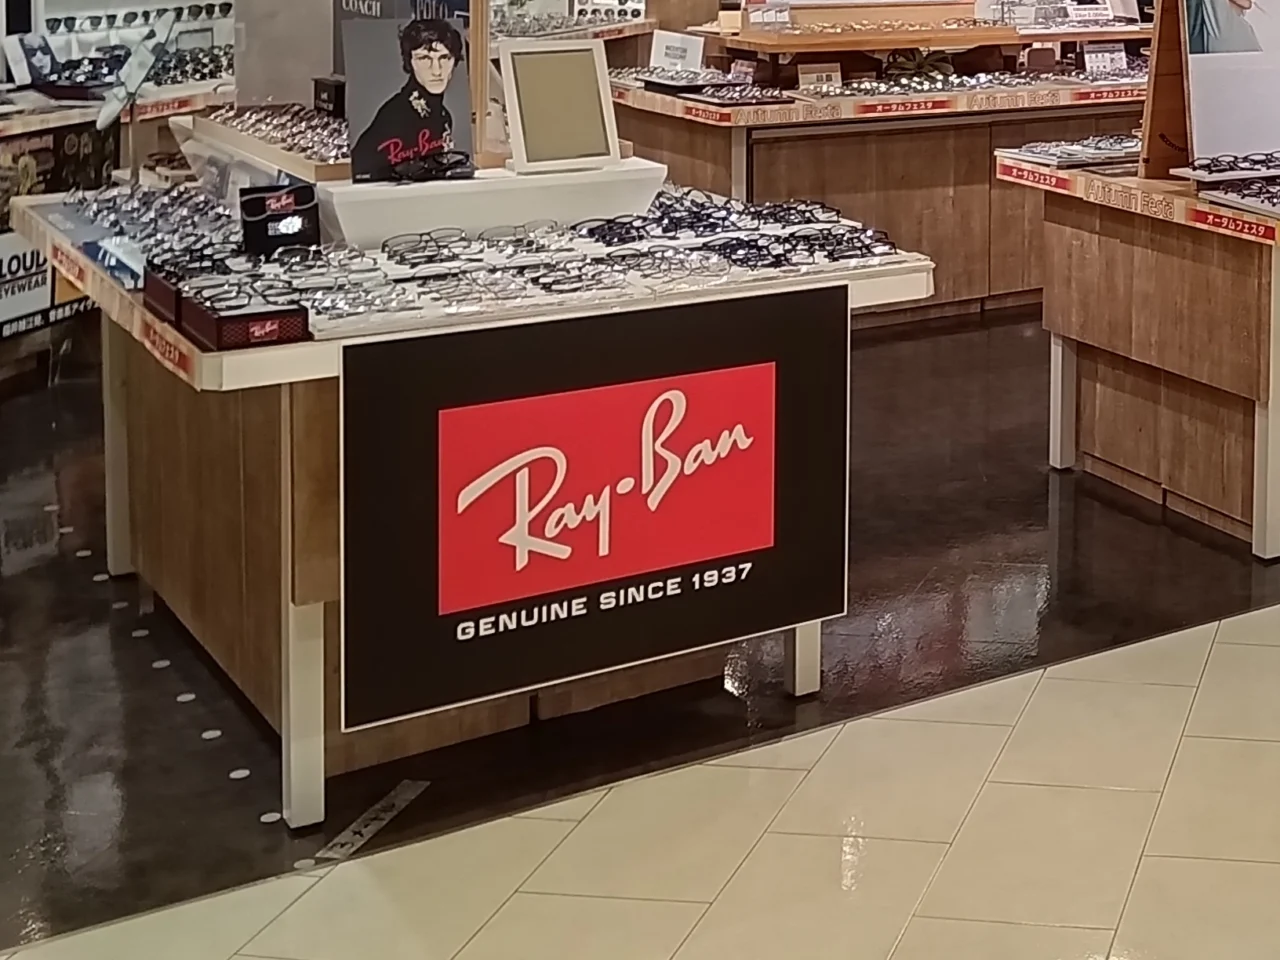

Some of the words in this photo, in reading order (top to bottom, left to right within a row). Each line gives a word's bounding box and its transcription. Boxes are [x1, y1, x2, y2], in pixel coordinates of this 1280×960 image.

[875, 100, 933, 113] オータムフェスタ
[968, 93, 1025, 110] Autumn
[1028, 91, 1061, 107] Festa
[735, 108, 799, 124] Autumn
[803, 103, 842, 119] Festa
[1010, 167, 1057, 187] オータムフェスタ
[1086, 180, 1138, 211] Autumn
[1140, 192, 1176, 220] Festa
[1206, 214, 1266, 236] オータムフェスタ
[456, 597, 588, 642] GENUINE
[599, 576, 682, 611] SINCE
[692, 561, 754, 592] 1937
